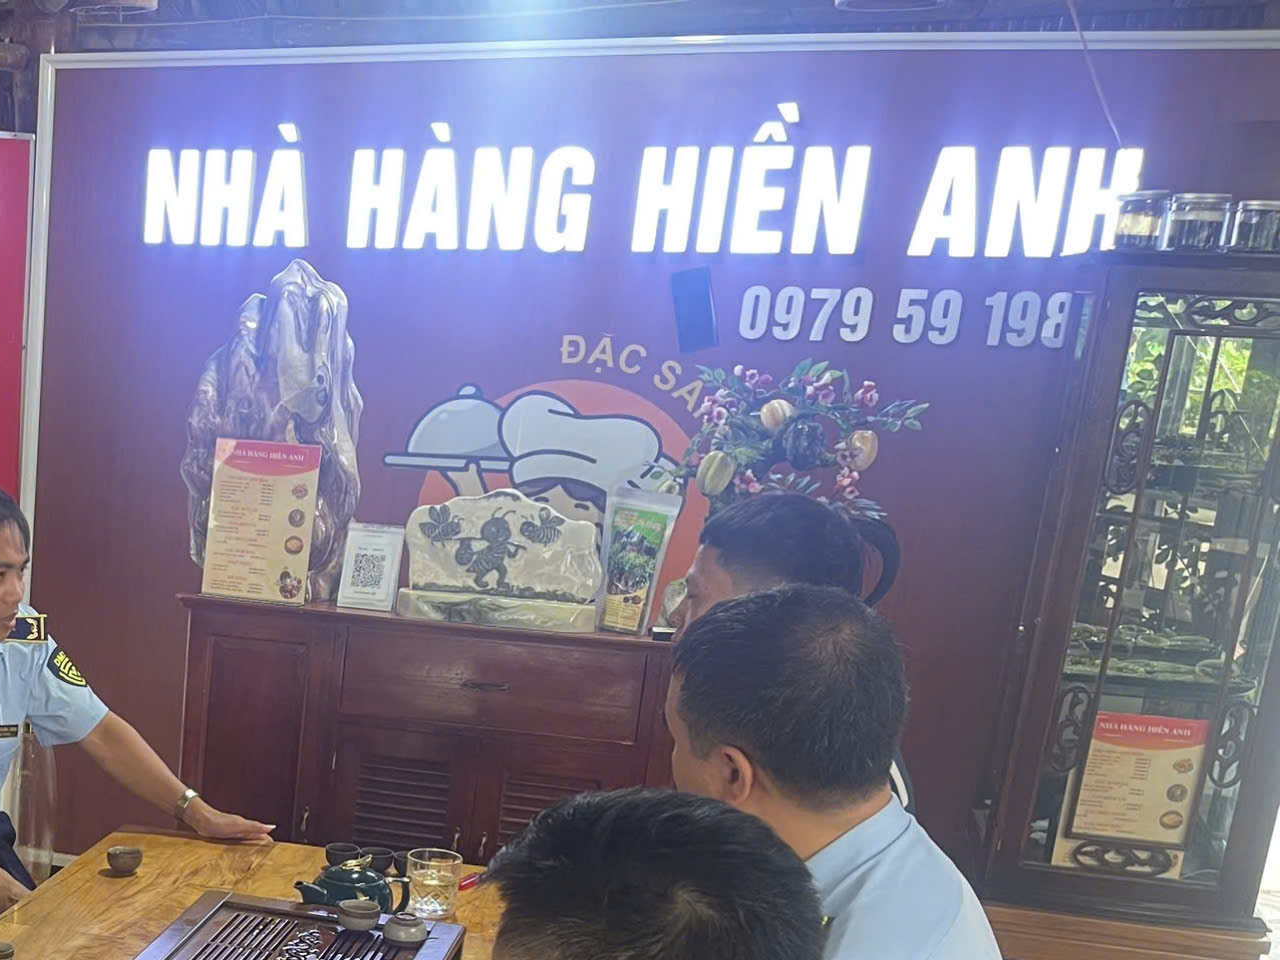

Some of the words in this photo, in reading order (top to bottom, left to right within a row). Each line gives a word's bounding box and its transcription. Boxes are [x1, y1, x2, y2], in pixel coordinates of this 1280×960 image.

[143, 122, 309, 247] NHÀ
[346, 122, 596, 253] HÀNG
[631, 102, 872, 256] HIỀN
[906, 145, 1145, 258] ANH
[738, 285, 874, 343] 0979
[892, 288, 963, 346] 59
[560, 332, 647, 375] ĐẶC
